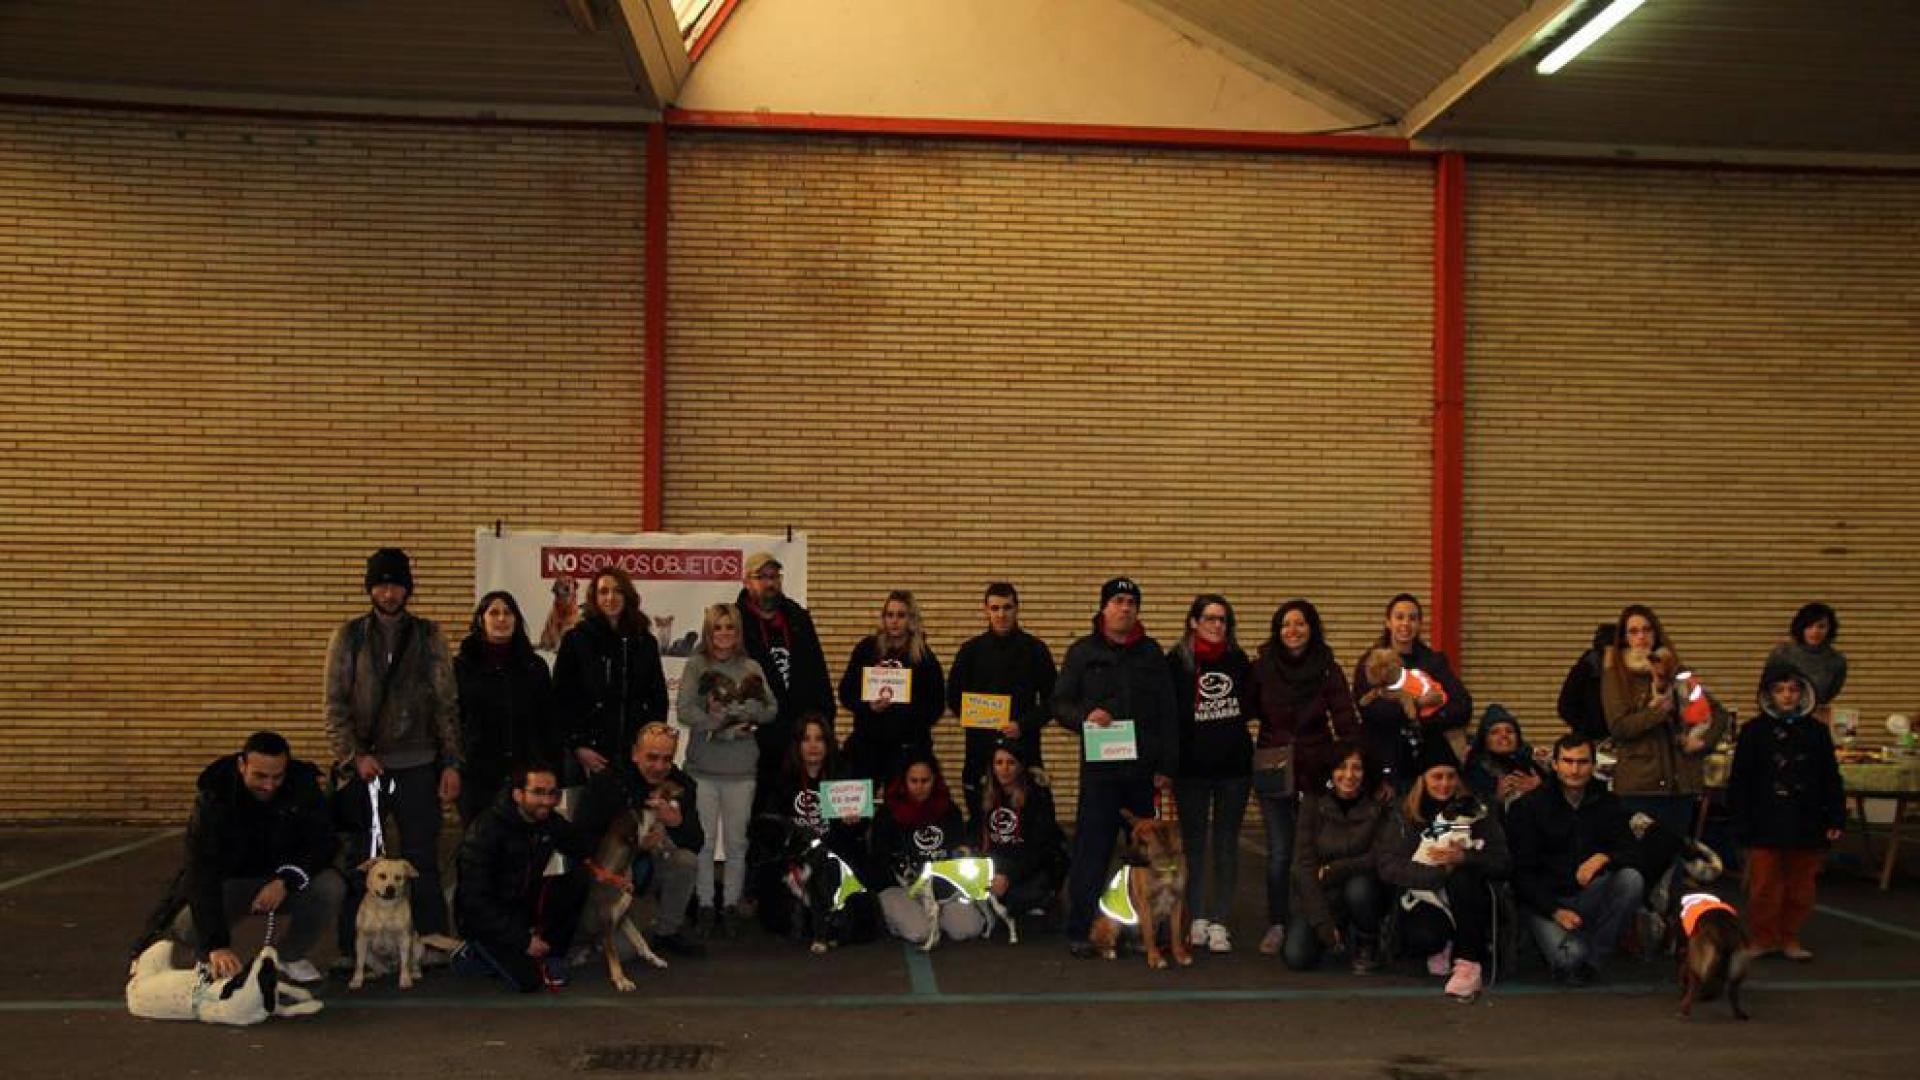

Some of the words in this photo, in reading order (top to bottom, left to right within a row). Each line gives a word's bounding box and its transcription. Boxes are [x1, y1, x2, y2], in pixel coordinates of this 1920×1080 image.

[548, 553, 577, 572] NO
[579, 553, 650, 575] SOMOS
[653, 555, 738, 575] OBJETOS
[1198, 697, 1239, 712] ADOPTA
[1194, 707, 1241, 721] NAVARRA
